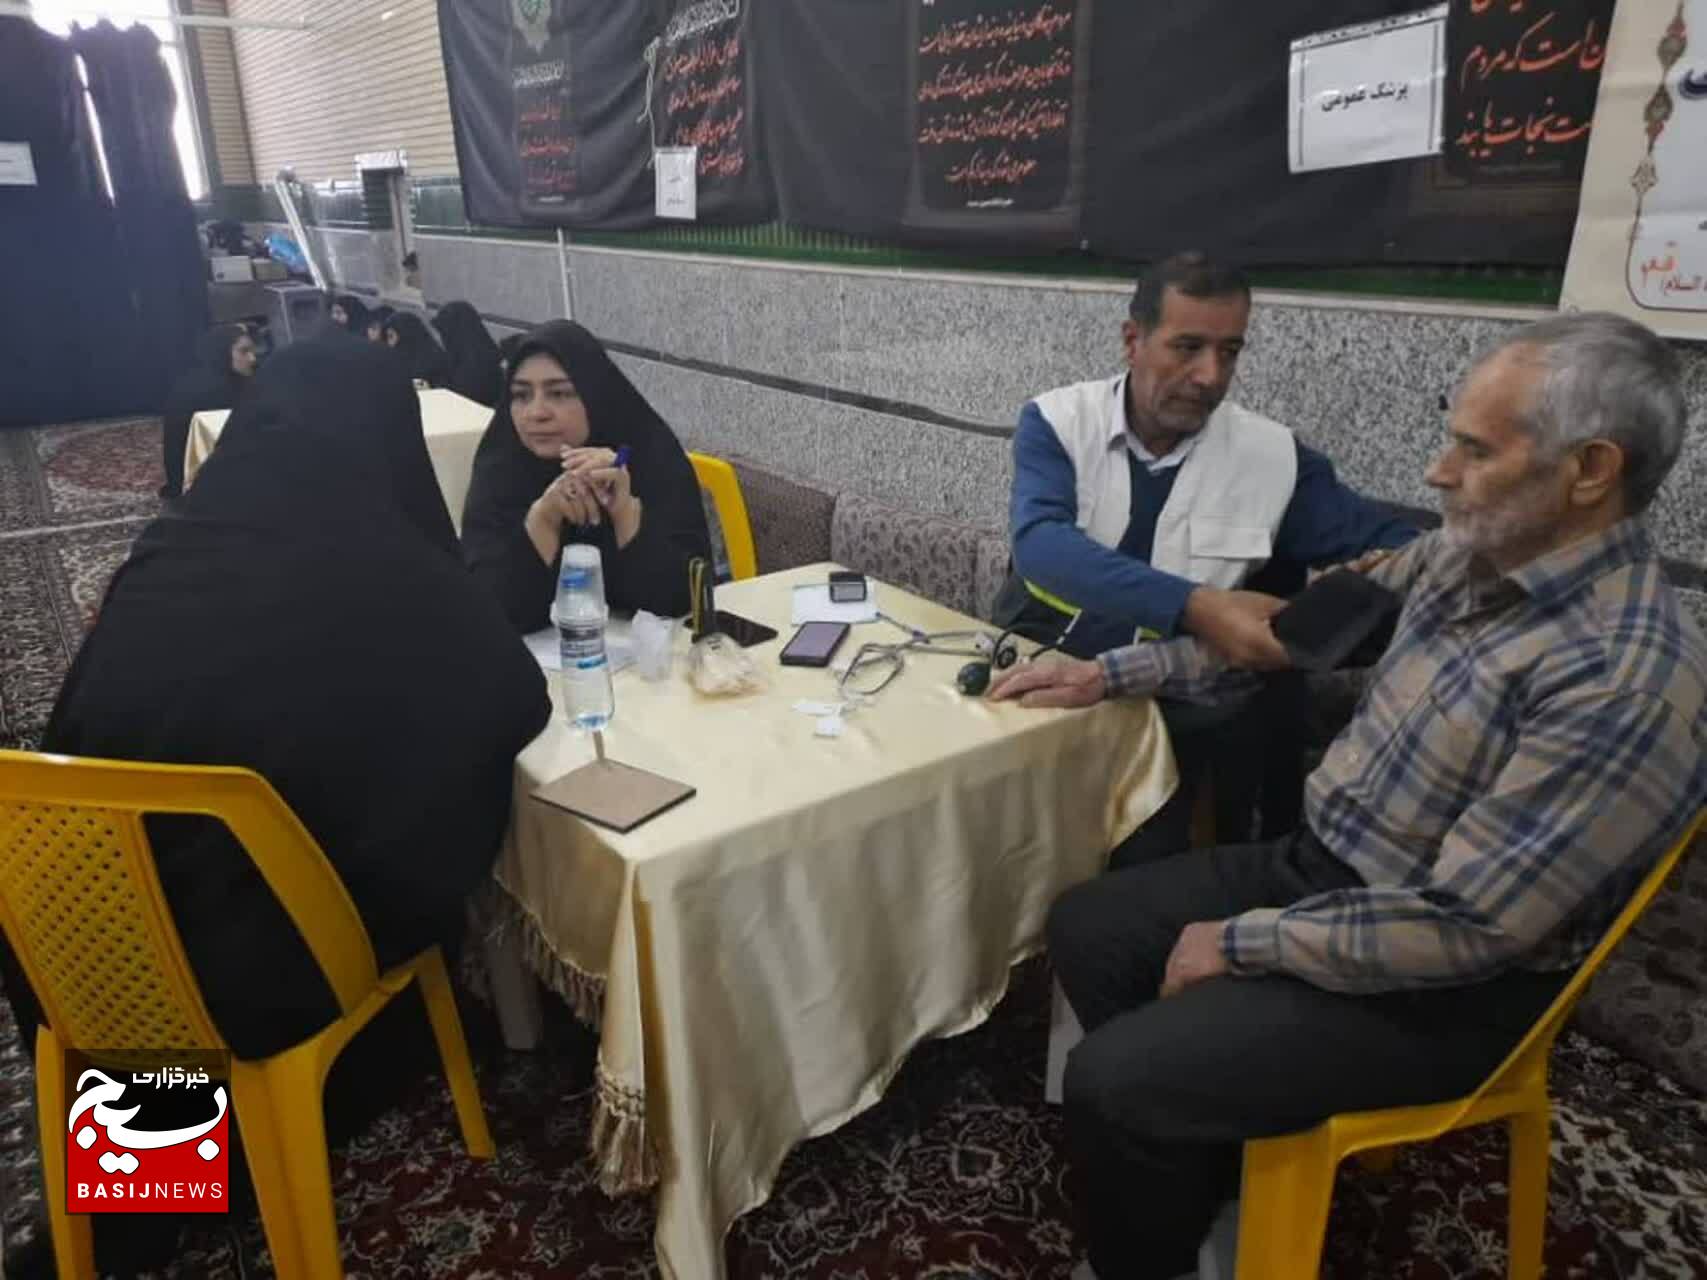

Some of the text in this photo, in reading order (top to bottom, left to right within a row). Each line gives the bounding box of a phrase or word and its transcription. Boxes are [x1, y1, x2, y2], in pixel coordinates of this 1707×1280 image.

[1460, 44, 1508, 94] مردم
[1321, 81, 1409, 113] پزشک عمومی
[1484, 96, 1558, 156] نجات
